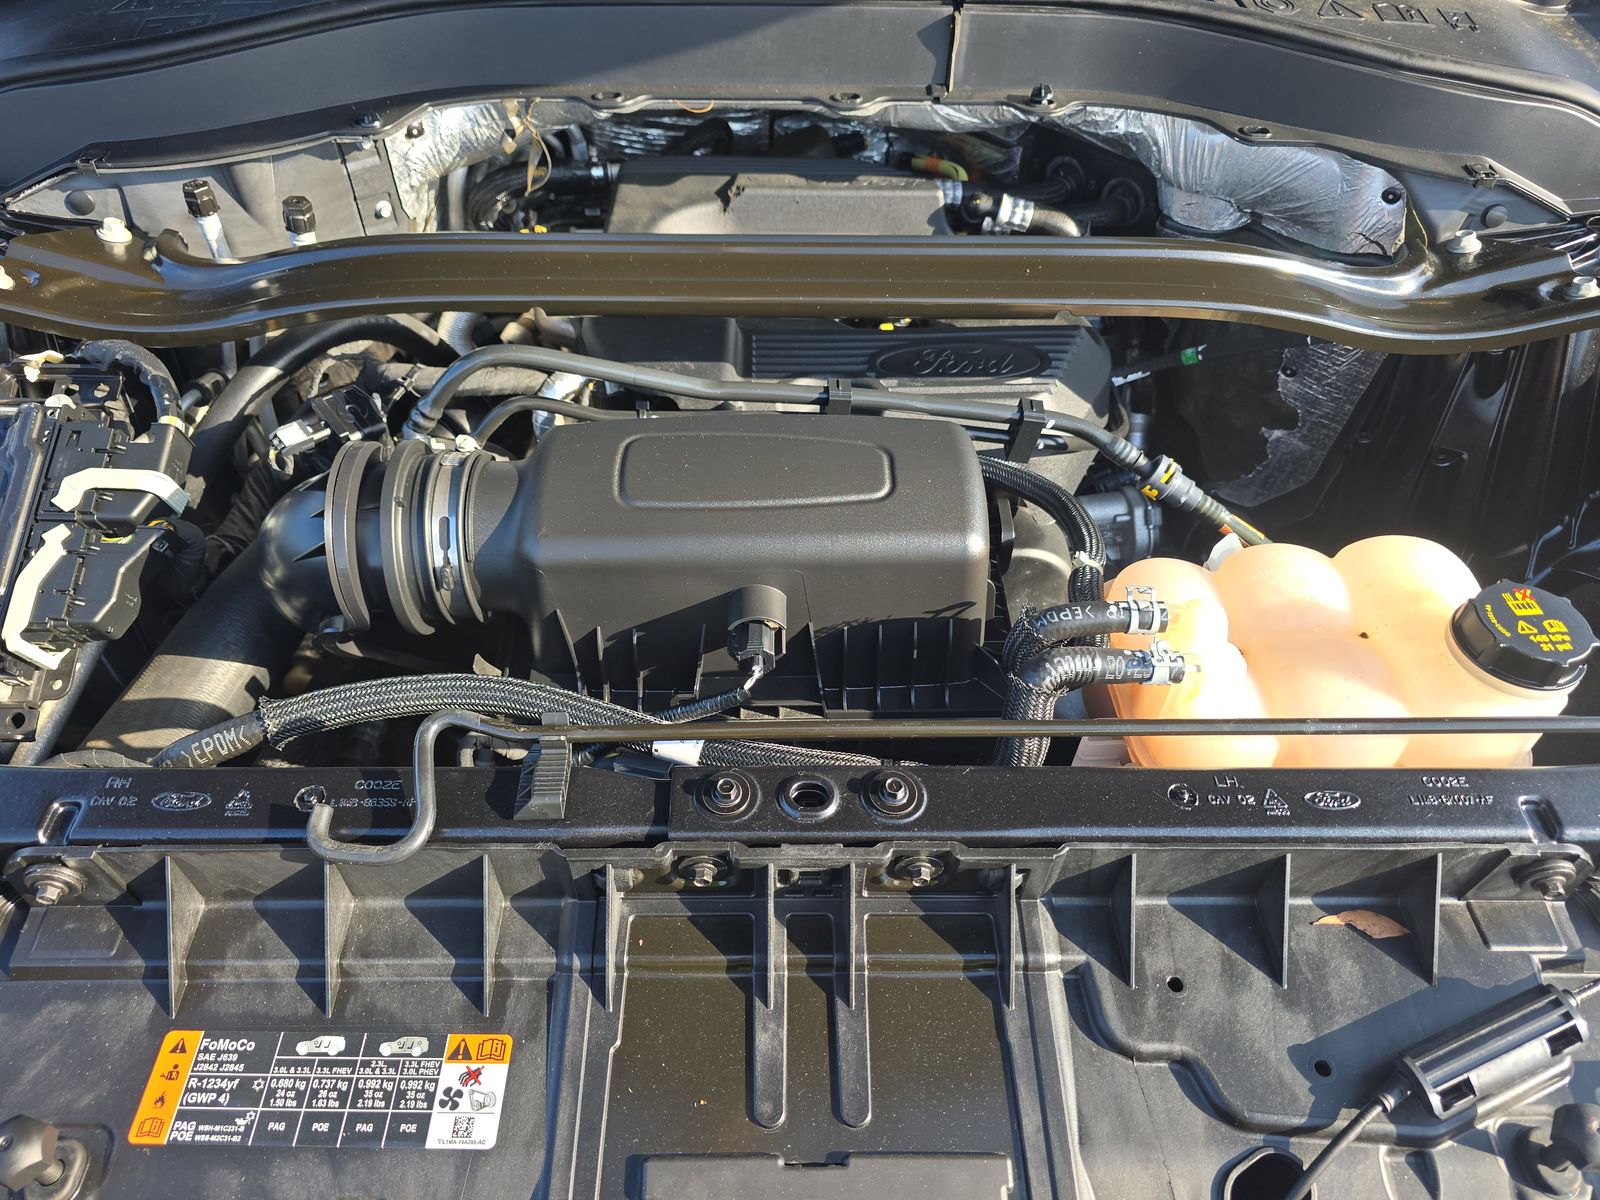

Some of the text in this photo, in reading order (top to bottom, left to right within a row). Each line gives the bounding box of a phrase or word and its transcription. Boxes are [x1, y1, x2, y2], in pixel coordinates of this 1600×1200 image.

[913, 347, 1015, 374] Ford
[200, 1038, 256, 1051] FoMoCo
[197, 1053, 239, 1061] SAE J639
[193, 1063, 245, 1072] J2842 J2845
[273, 1066, 288, 1074] 3.0L
[316, 1067, 353, 1075] 3.3L FHEV
[418, 1068, 439, 1076] PHEV
[188, 1077, 240, 1092] R-1234yf
[270, 1078, 307, 1091] 0.680 kg
[312, 1079, 349, 1092] 0.737 kg
[357, 1079, 394, 1092] 0.992 kg
[399, 1080, 436, 1093] 0.992 kg
[275, 1089, 286, 1097] 24
[182, 1092, 230, 1107] (GWP 4)
[285, 1099, 297, 1107] lbs
[328, 1100, 340, 1108] lbs
[356, 1099, 386, 1108] 2.19 lbs
[398, 1100, 428, 1109] 2.19 lbs
[173, 1121, 197, 1131] PAG
[267, 1122, 286, 1131] PAG
[311, 1122, 330, 1132] POE
[355, 1123, 374, 1132] PAG
[399, 1123, 418, 1132] POE
[169, 1131, 194, 1141] POE
